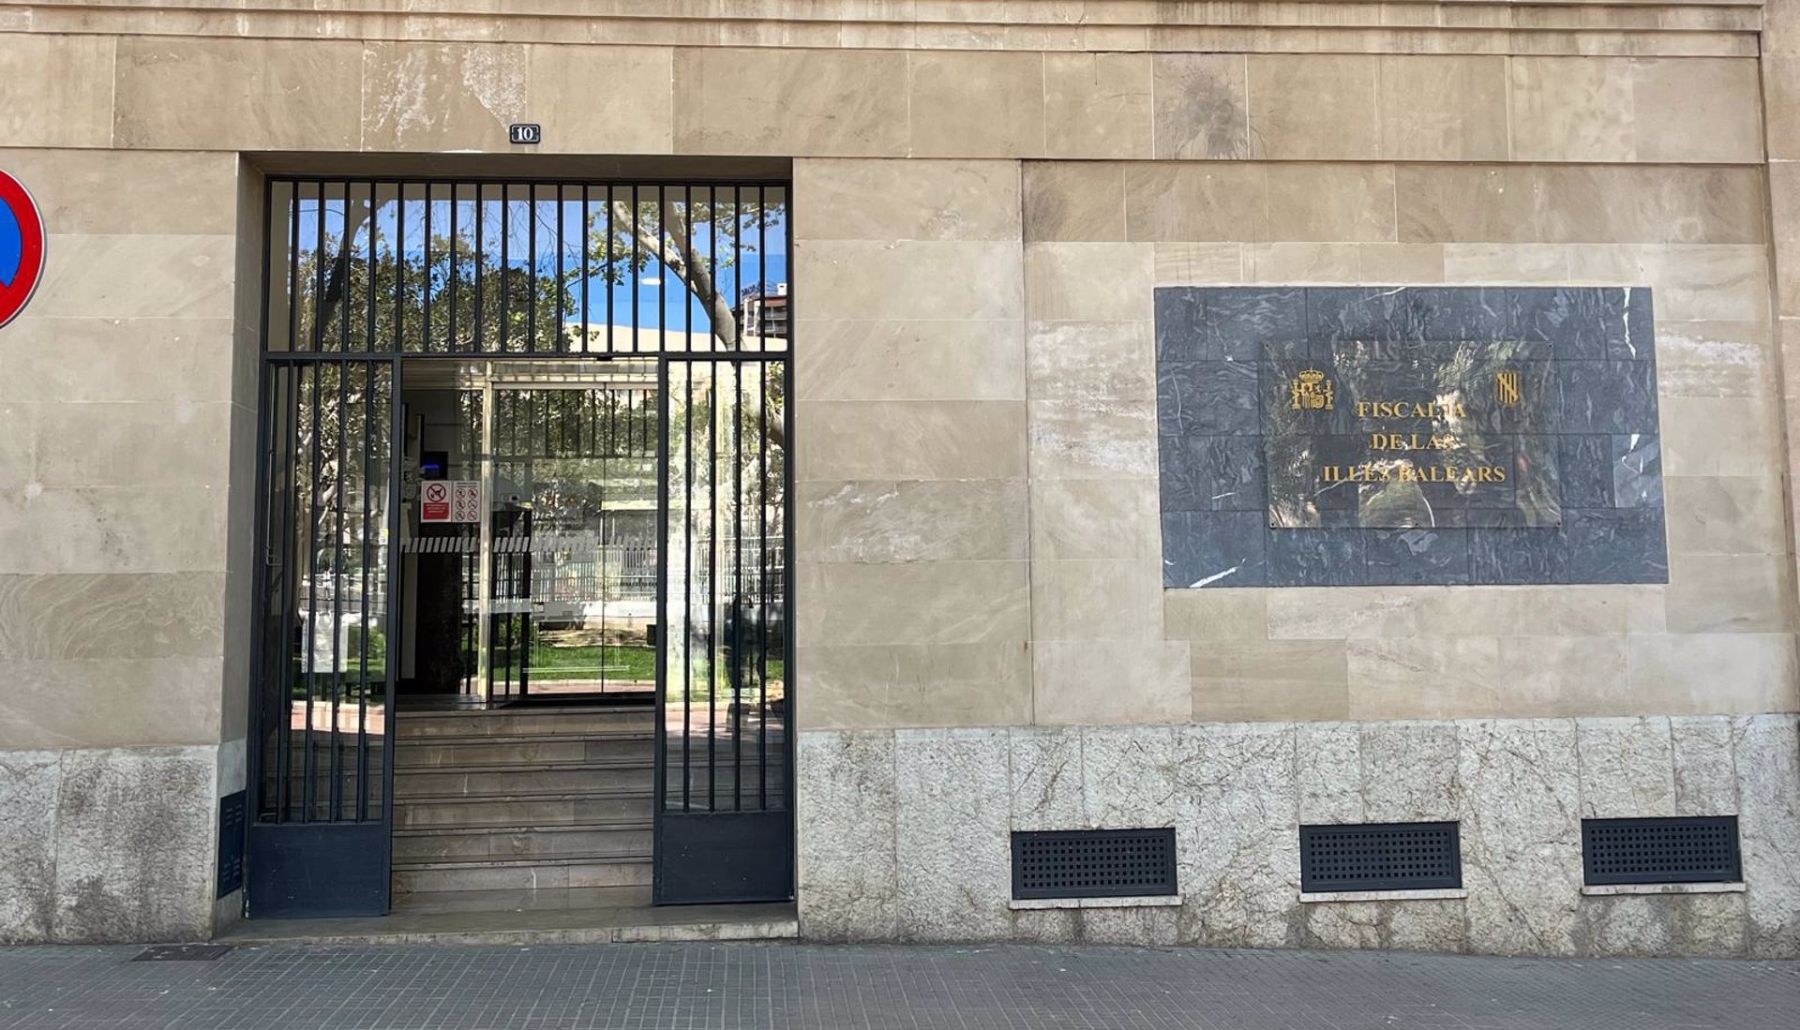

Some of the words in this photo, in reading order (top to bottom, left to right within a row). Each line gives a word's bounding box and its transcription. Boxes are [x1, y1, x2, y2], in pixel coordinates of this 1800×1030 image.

[517, 127, 533, 140] 10
[1371, 433, 1403, 450] DE
[1397, 465, 1506, 482] BALEARS
